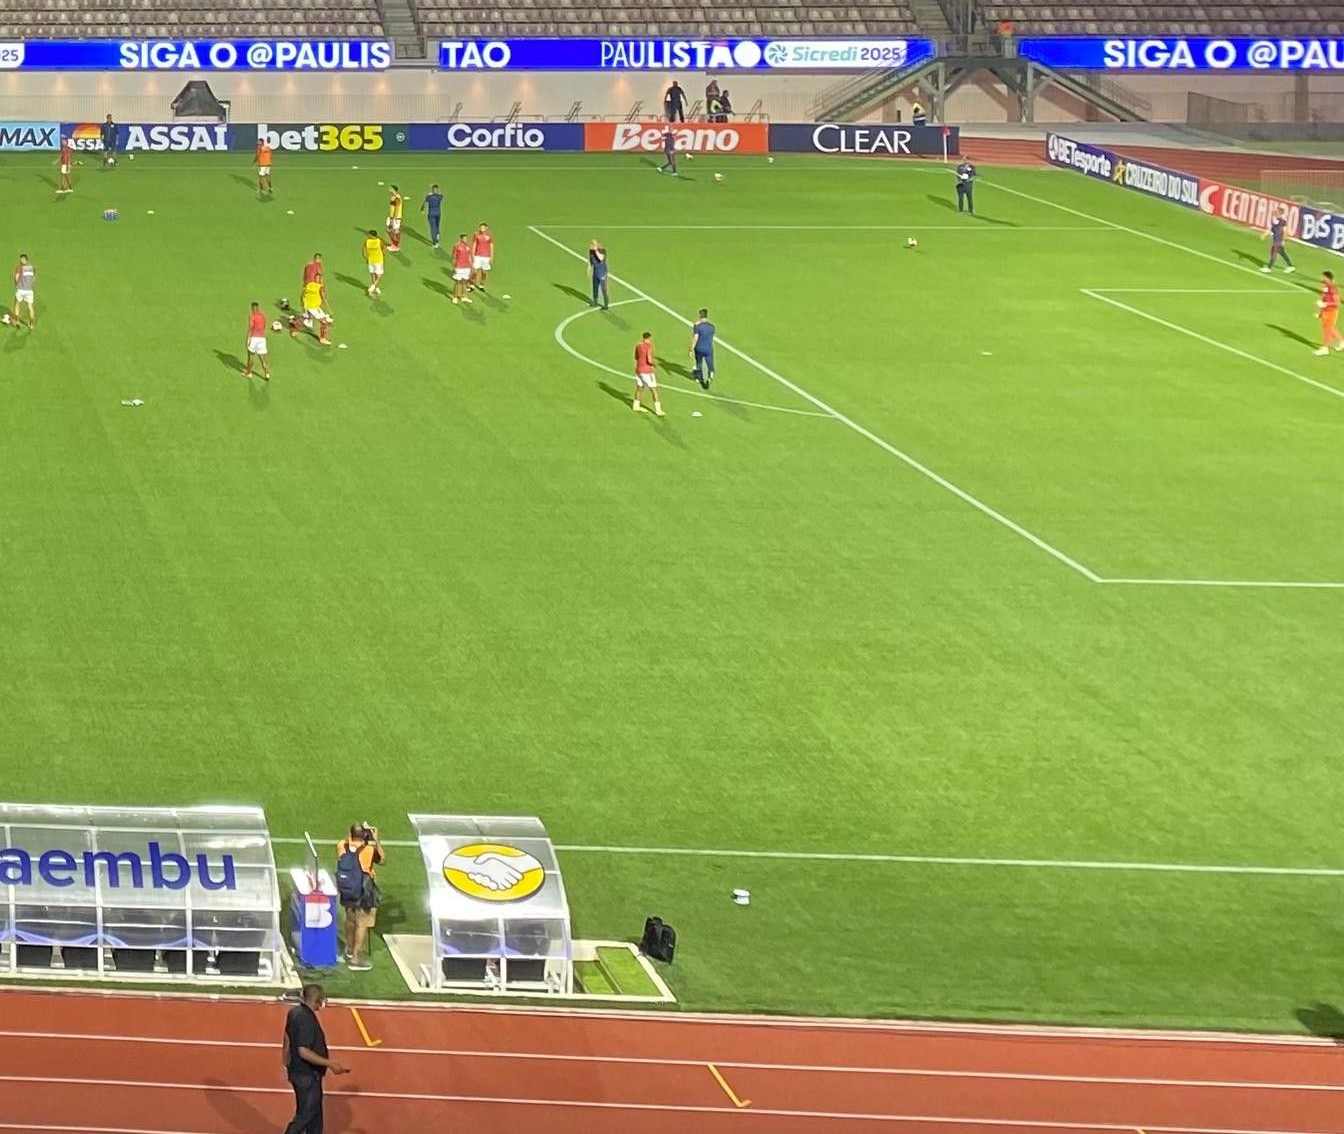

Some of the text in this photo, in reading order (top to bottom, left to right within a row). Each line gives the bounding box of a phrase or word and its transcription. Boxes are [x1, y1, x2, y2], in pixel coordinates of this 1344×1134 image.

[119, 42, 391, 69] SIGA O @PAULIS
[442, 41, 512, 68] TAO
[792, 46, 858, 62] Sicredi
[860, 47, 901, 62] 2025
[1103, 40, 1344, 69] SIGA O @PAU
[67, 138, 106, 151] ASSA
[257, 123, 384, 151] bet365
[447, 123, 545, 148] Corfio
[812, 124, 912, 154] CLEAR
[1058, 138, 1112, 178] BETesporte
[1125, 162, 1200, 206] CRUZEIRO DO SUL
